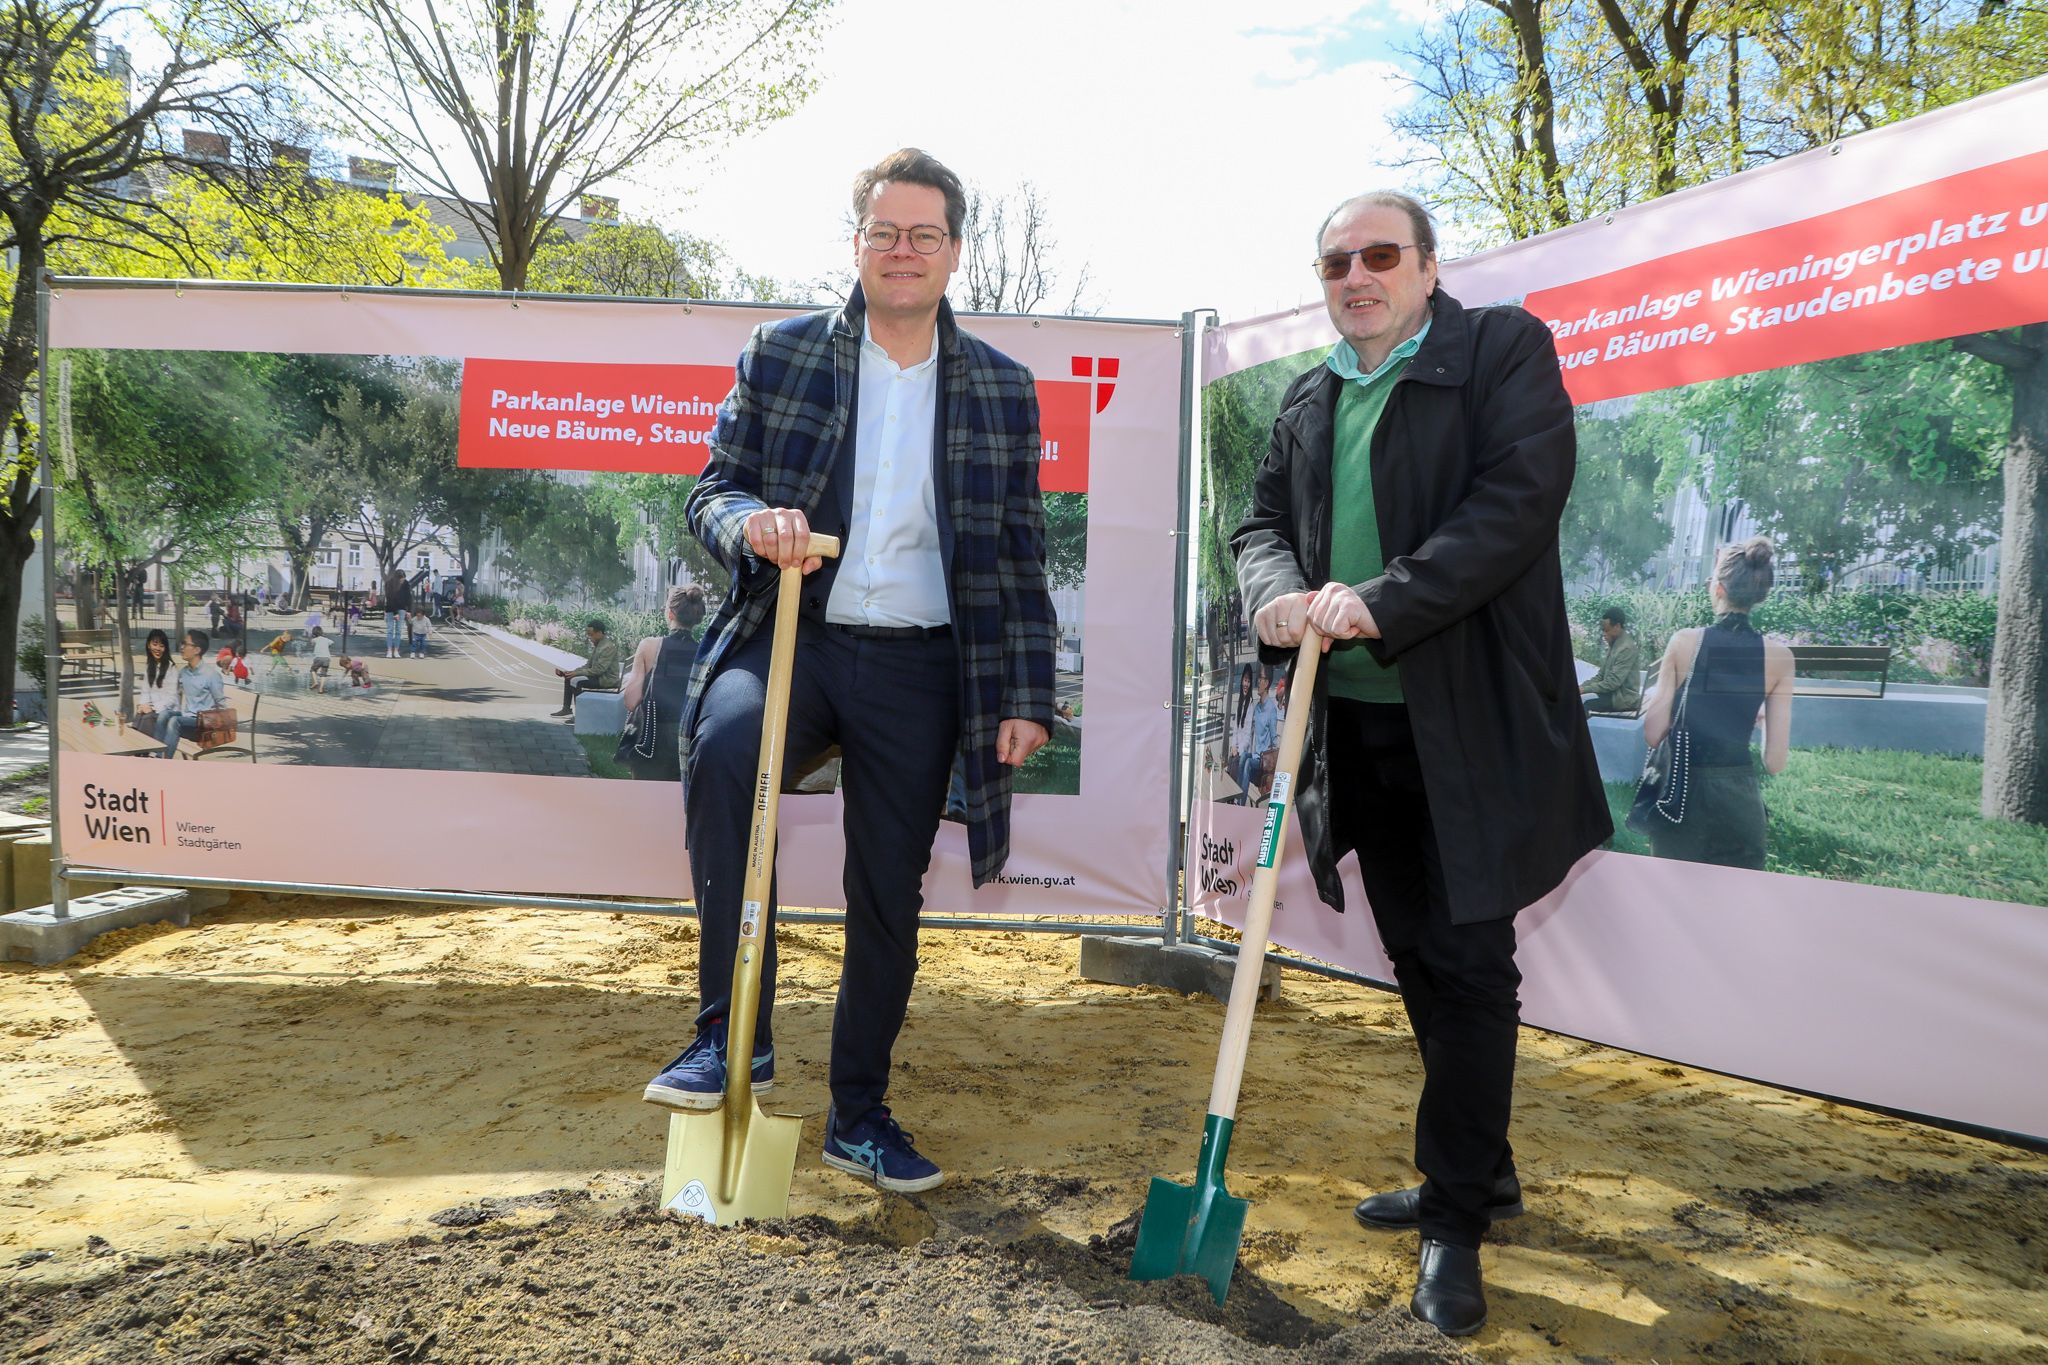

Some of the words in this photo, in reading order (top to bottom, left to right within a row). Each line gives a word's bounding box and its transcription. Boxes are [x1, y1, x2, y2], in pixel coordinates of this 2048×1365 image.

[1545, 287, 1702, 339] Parkanlage
[1710, 211, 2011, 303] Wieningerplatz
[1603, 324, 1718, 362] Bäume,
[1726, 257, 2003, 335] Staudenbeete
[490, 388, 625, 418] Parkanlage
[489, 417, 550, 439] Neue
[556, 419, 643, 446] Bäume,
[84, 783, 149, 814] Stadt
[84, 813, 151, 844] Wien
[176, 821, 216, 834] Wiener
[177, 837, 242, 852] Stadtgärten
[1201, 832, 1234, 866] Stadt
[1257, 829, 1271, 865] Austria
[989, 872, 1076, 888] rk.wien.gv.at
[1201, 865, 1237, 897] Wien
